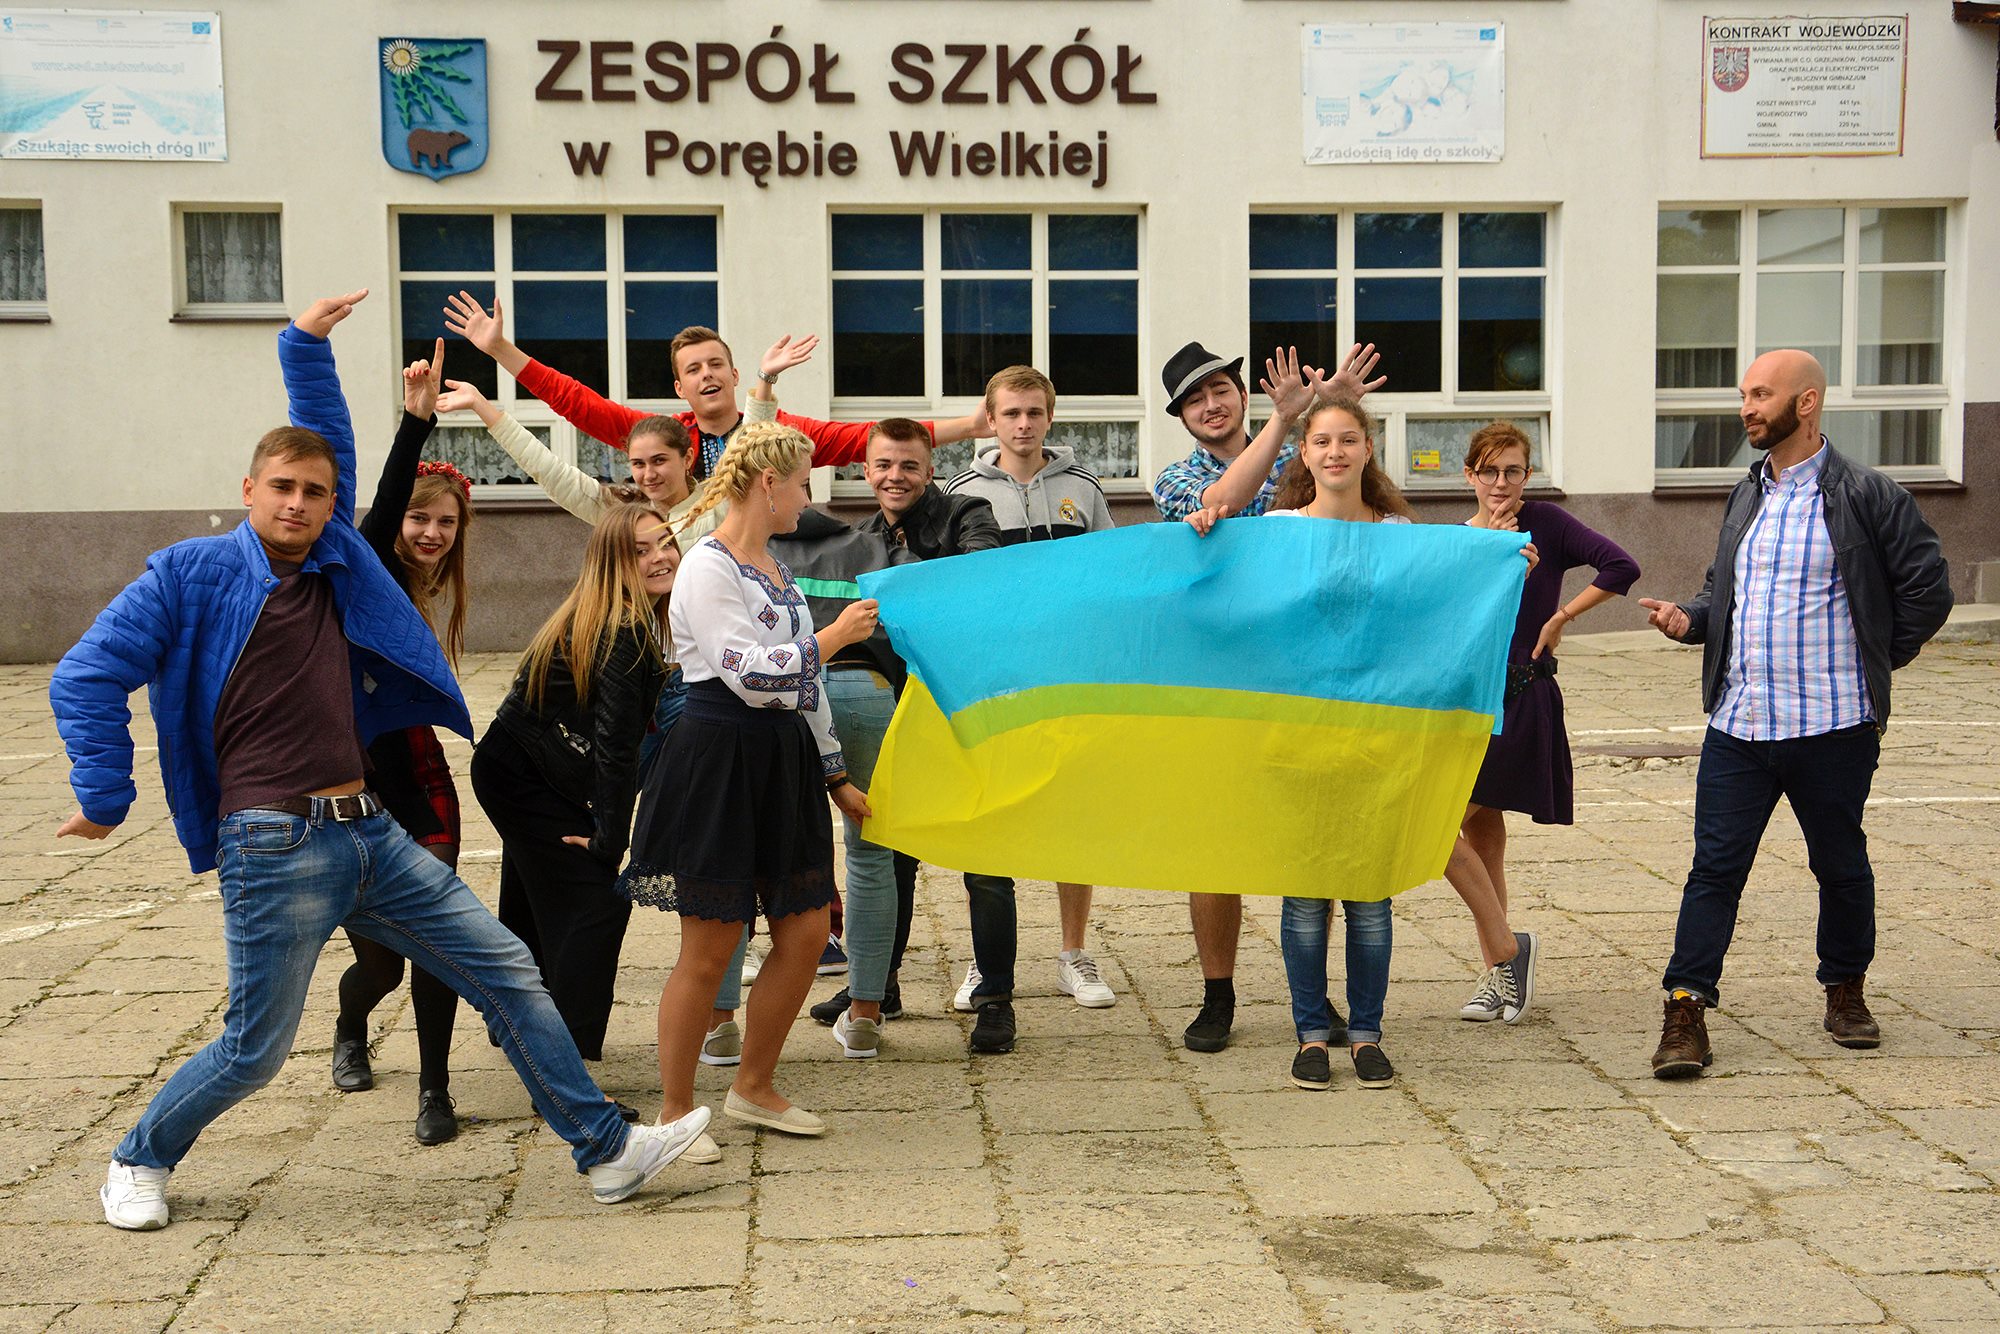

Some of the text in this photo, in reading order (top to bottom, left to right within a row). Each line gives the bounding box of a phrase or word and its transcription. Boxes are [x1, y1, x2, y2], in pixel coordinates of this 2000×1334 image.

[1710, 22, 1900, 38] KONTRAKT WOJEWÓDZKI
[534, 25, 1158, 105] ZESPÓŁ SZKÓŁ
[95, 140, 152, 154] swoich
[156, 141, 194, 157] dróg
[1328, 146, 1392, 160] radością
[1396, 146, 1418, 160] idę
[1424, 145, 1442, 158] do
[563, 130, 1109, 189] w Porębie Wielkiej
